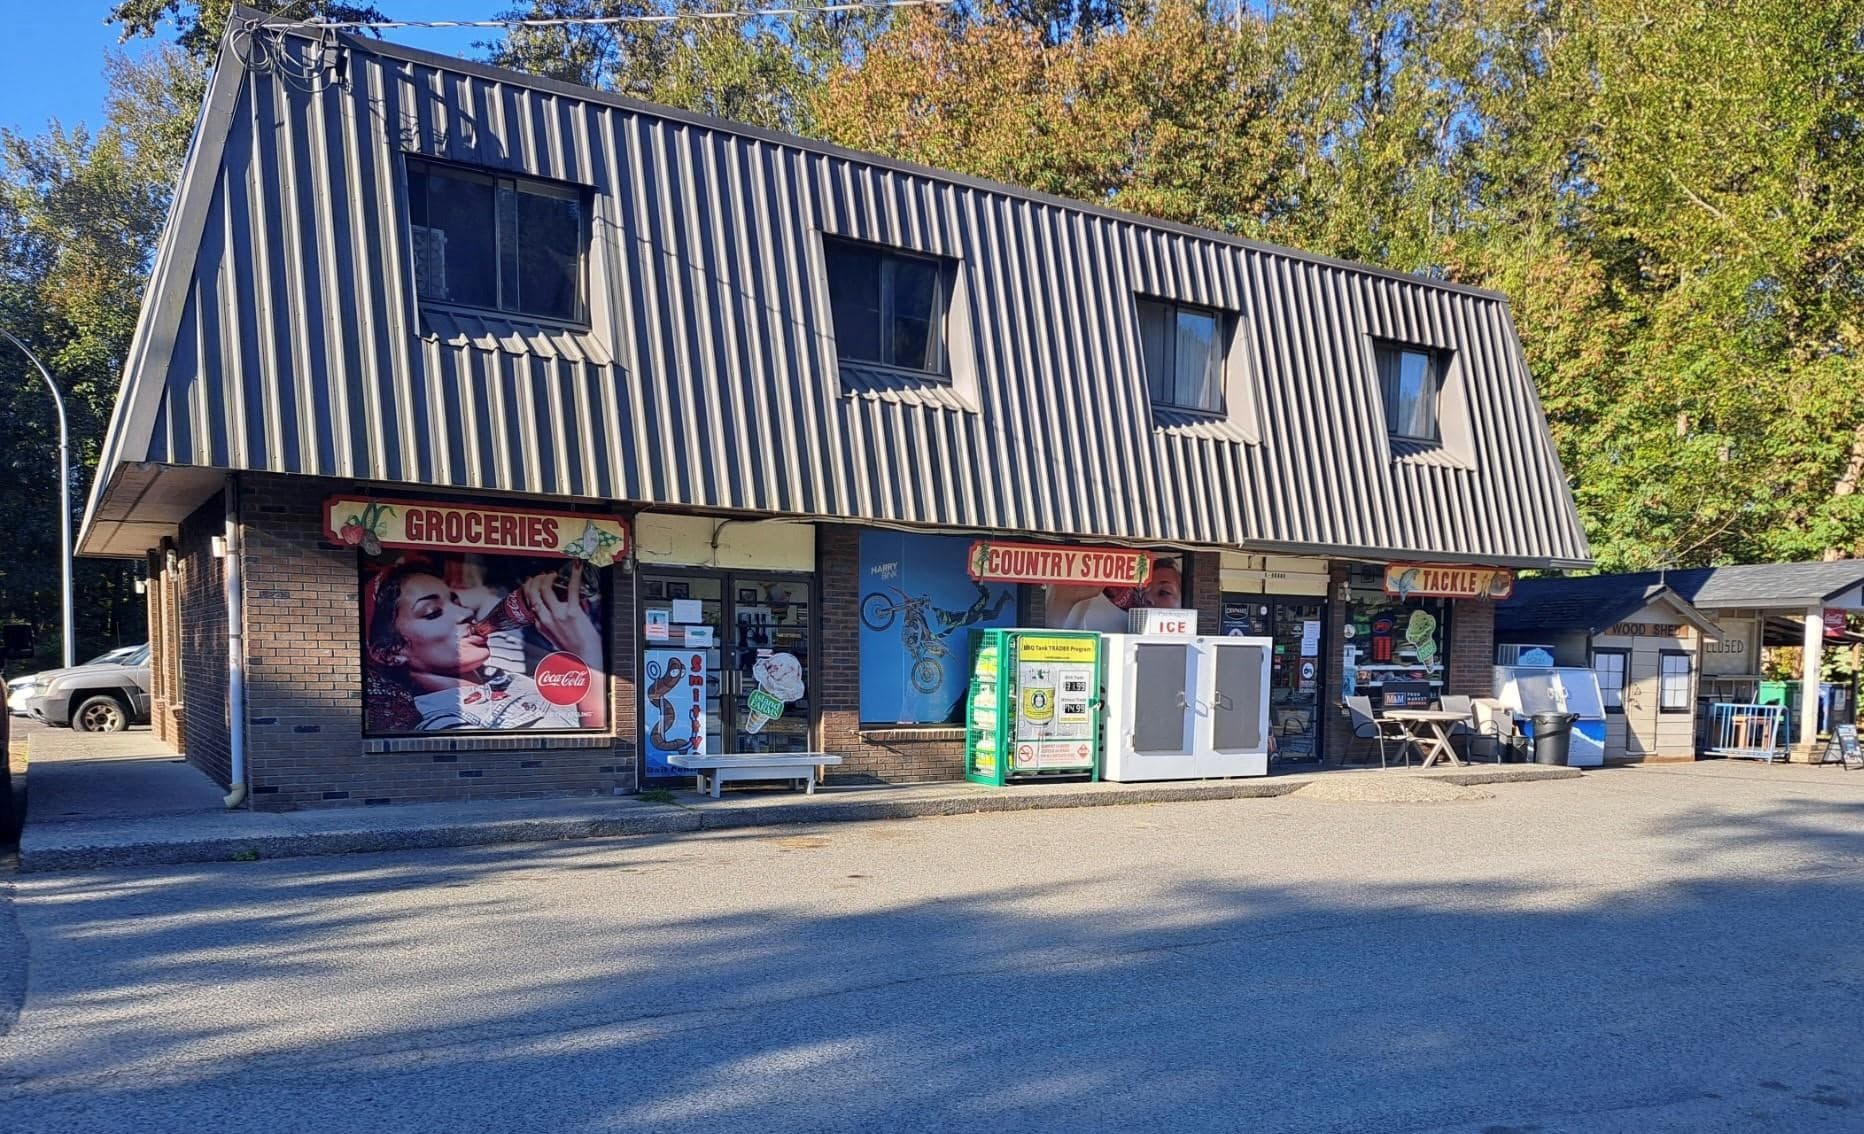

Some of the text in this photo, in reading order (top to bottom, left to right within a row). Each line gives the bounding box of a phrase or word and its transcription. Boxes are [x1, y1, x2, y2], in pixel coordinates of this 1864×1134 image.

[405, 509, 559, 549] GROCERIES
[988, 549, 1137, 580] COUNTRY STORE
[1423, 570, 1477, 592] TACKLE
[1159, 621, 1186, 633] ICE
[1612, 623, 1646, 635] WOOD
[1706, 640, 1744, 654] CLOSED
[538, 670, 588, 687] Coca-Cola
